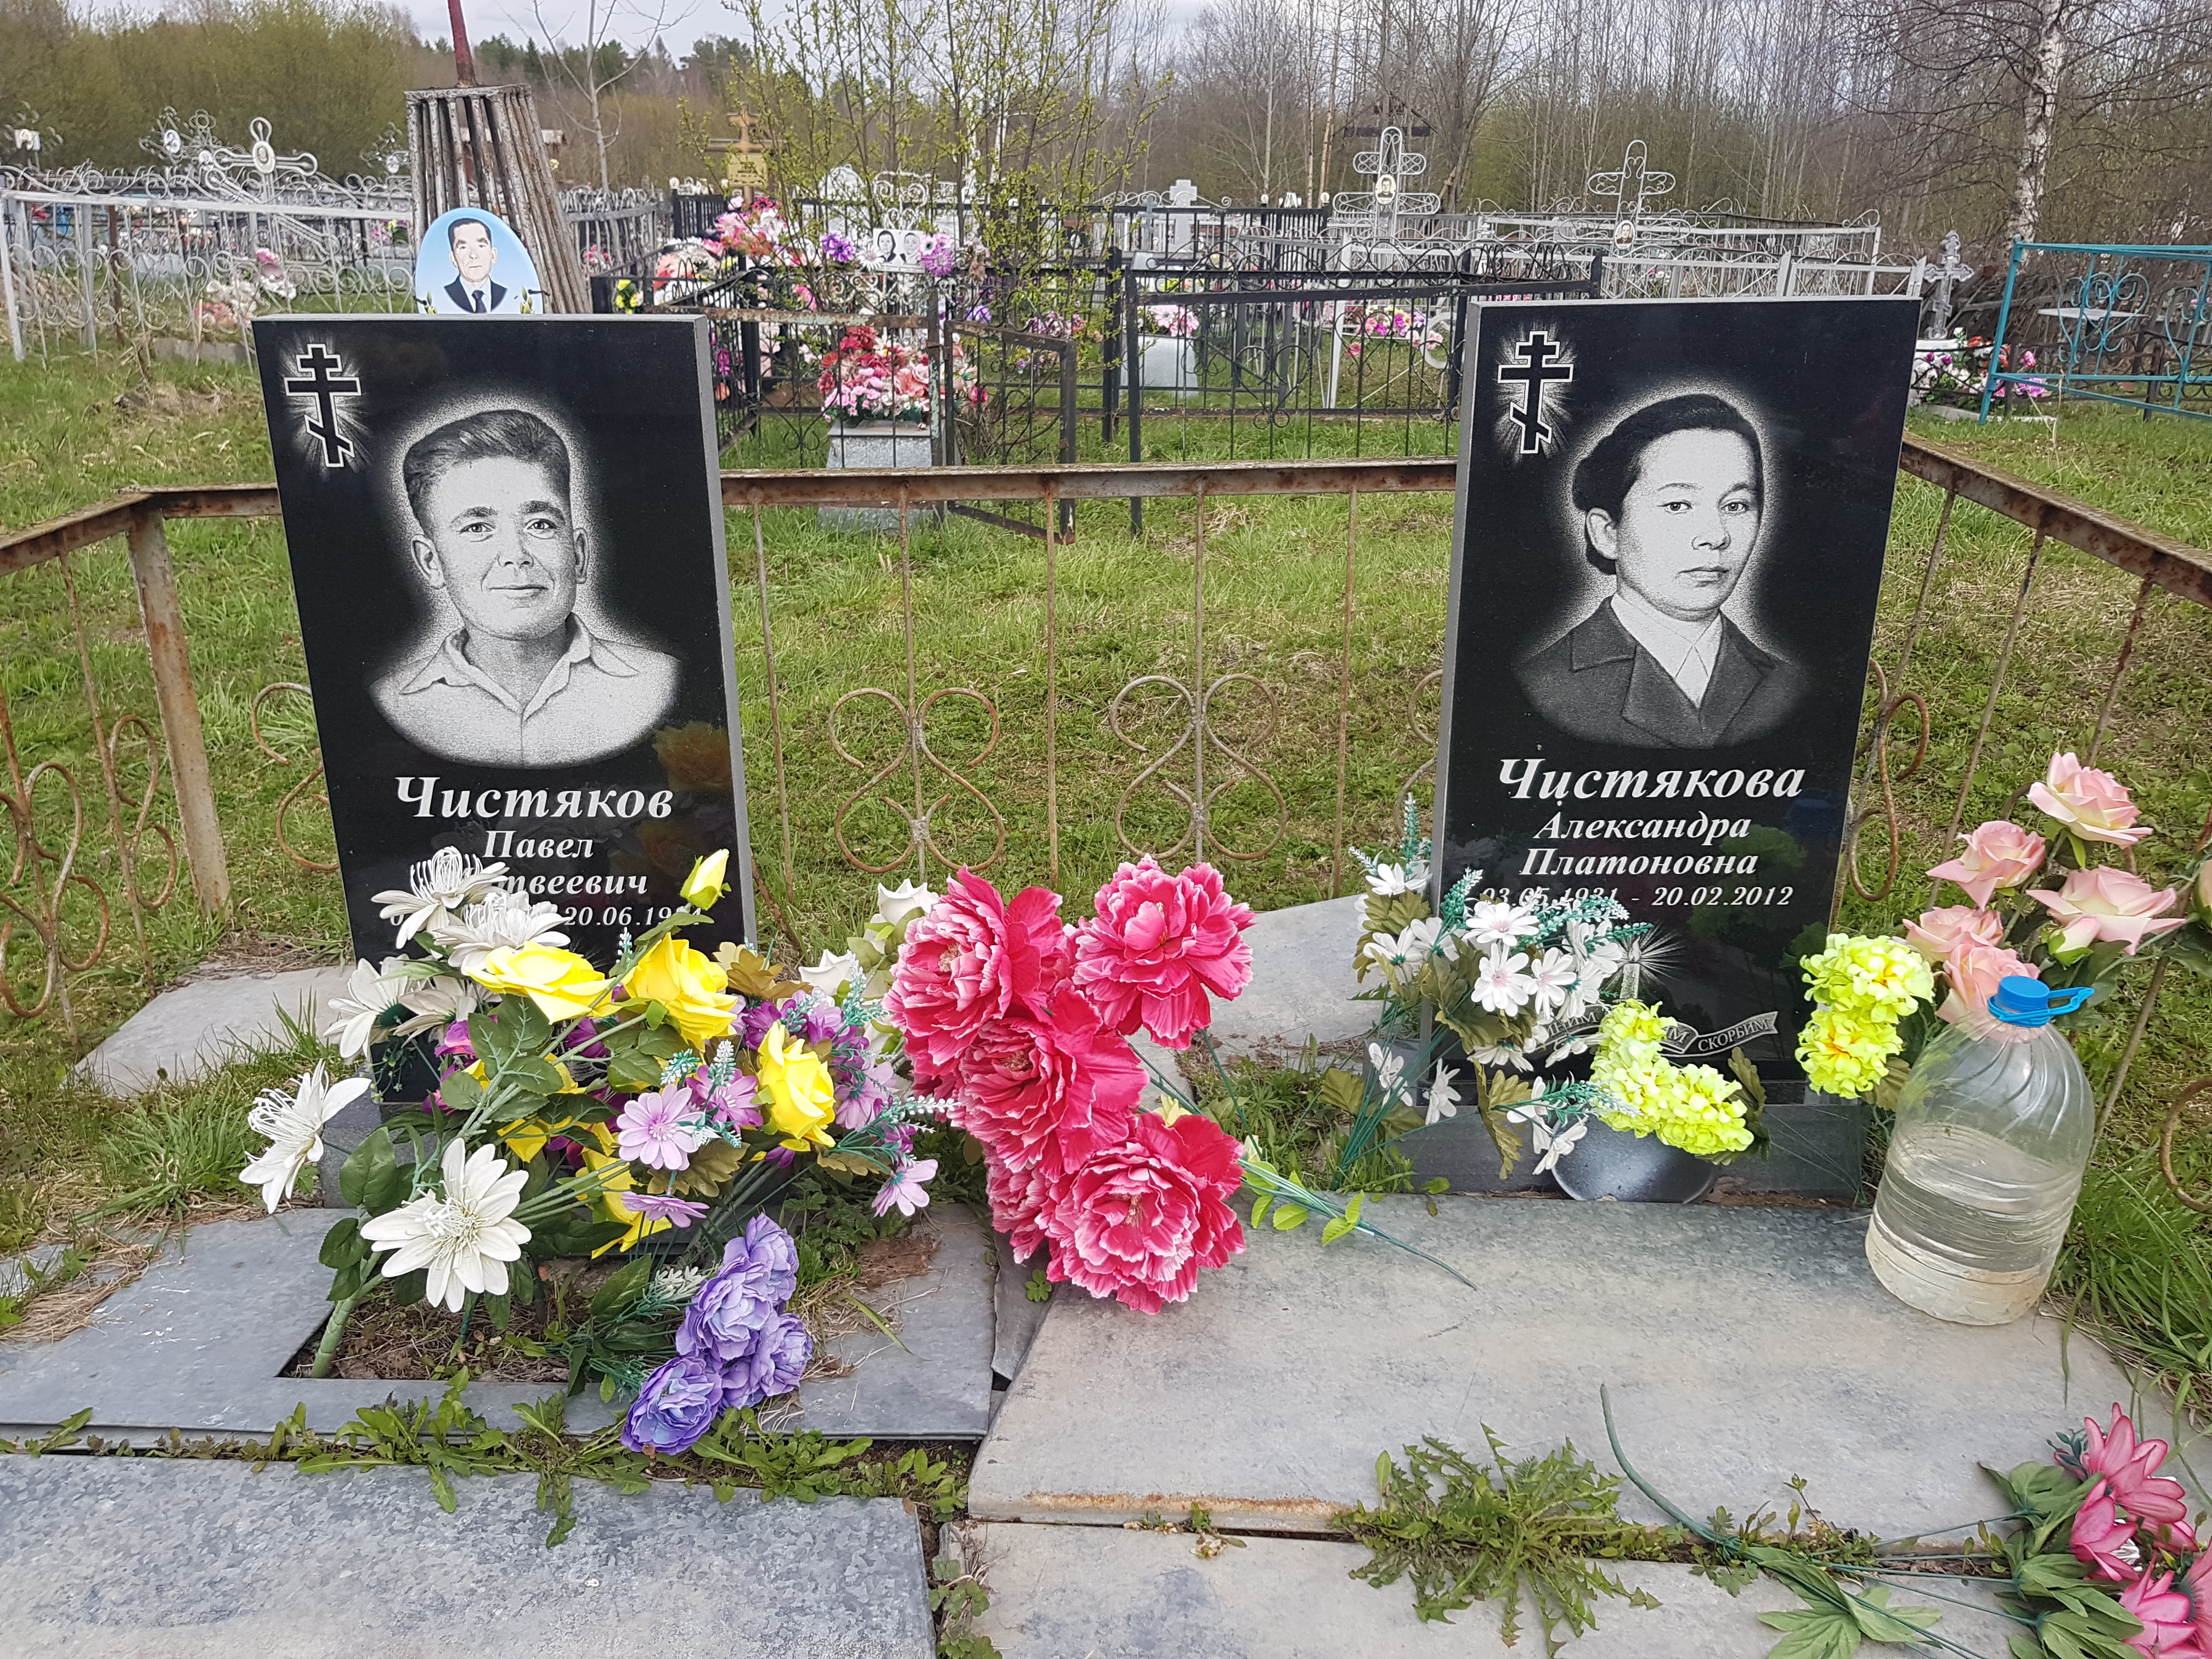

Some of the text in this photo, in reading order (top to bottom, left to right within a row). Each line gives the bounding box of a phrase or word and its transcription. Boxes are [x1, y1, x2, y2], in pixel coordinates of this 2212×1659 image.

[1499, 758, 1805, 799] Чистякова
[395, 777, 673, 818] Чистяков
[1533, 810, 1752, 846] Александра
[482, 830, 594, 858] Павел
[1520, 848, 1758, 875] Платоновна
[462, 868, 647, 894] твеевич
[1481, 887, 1617, 906] 03.051931
[1651, 887, 1793, 906] 20.02.2012
[1698, 1019, 1770, 1052] СКОРБИМ
